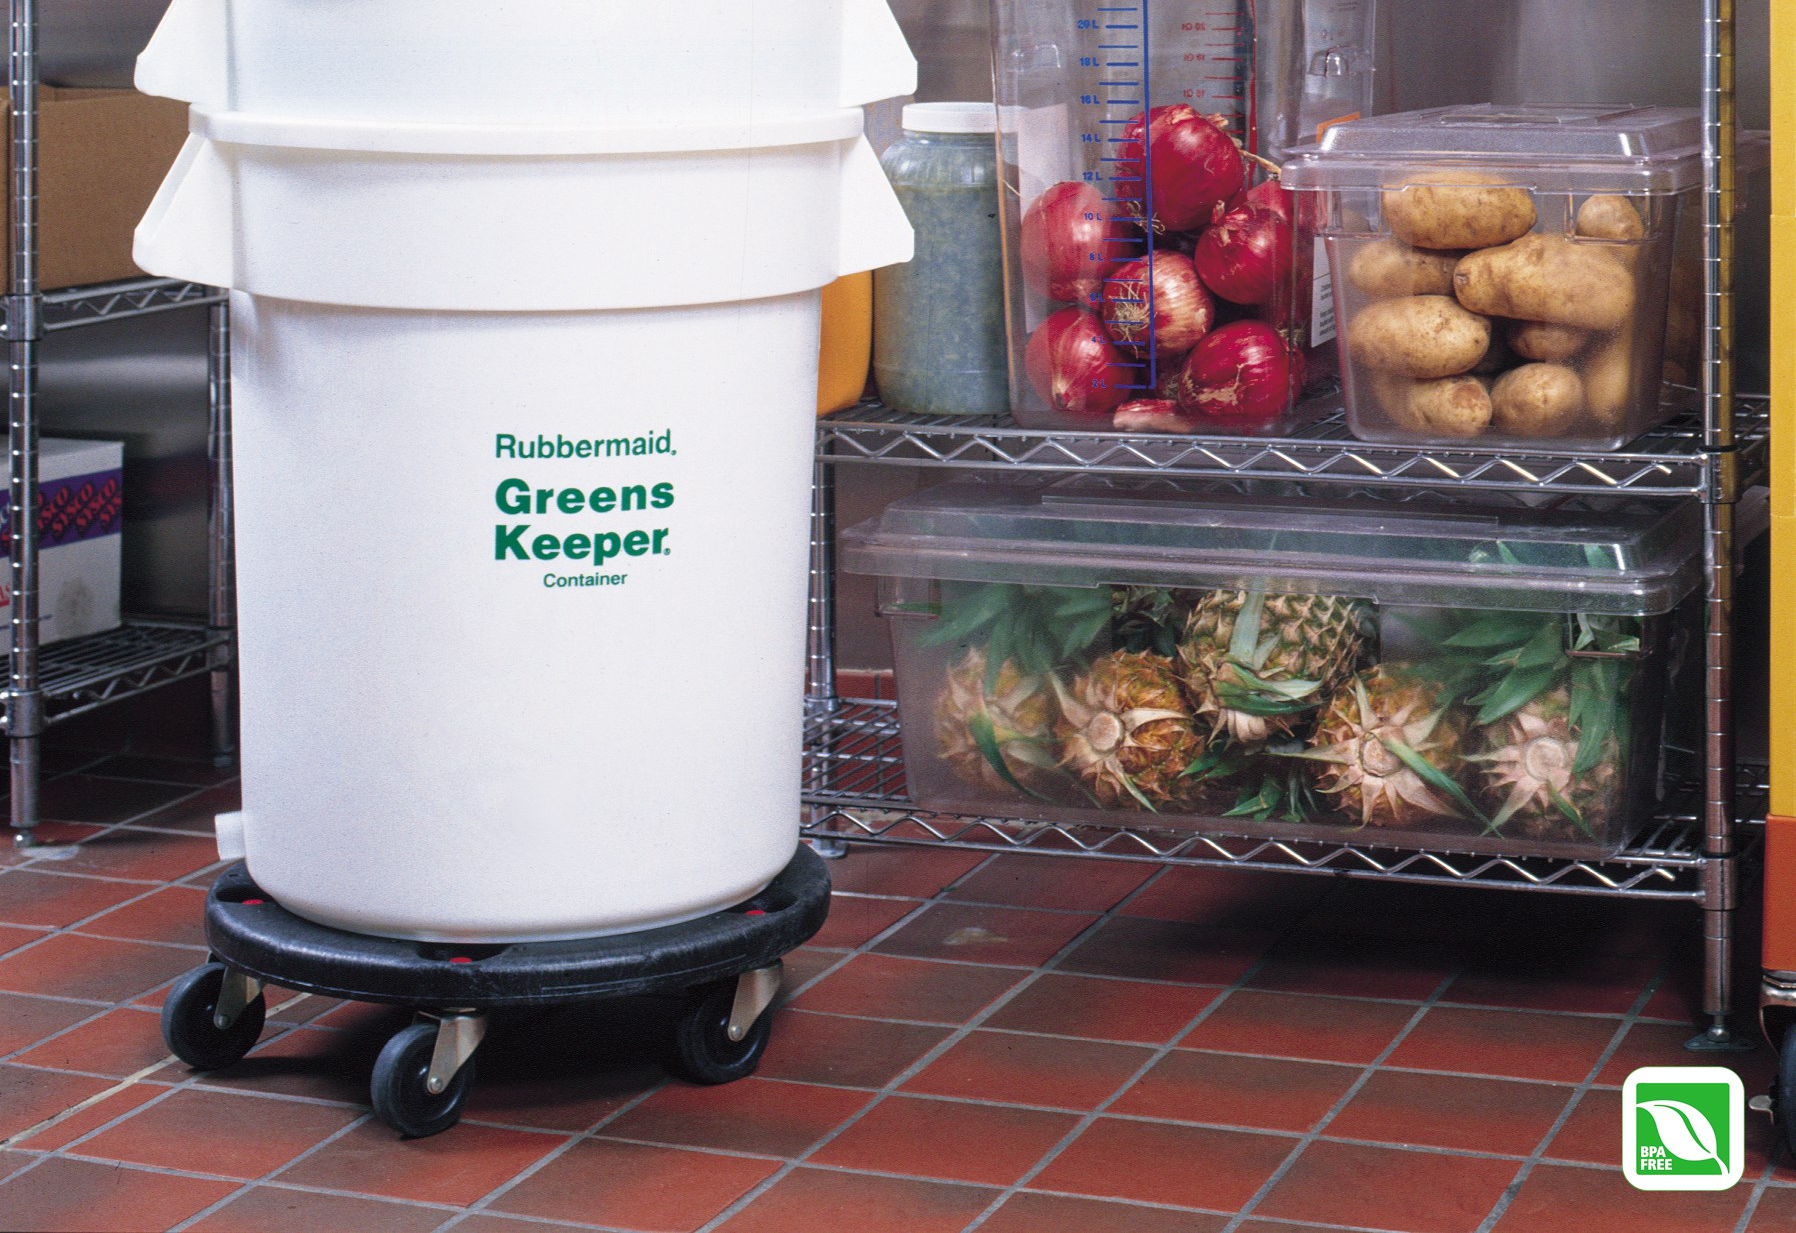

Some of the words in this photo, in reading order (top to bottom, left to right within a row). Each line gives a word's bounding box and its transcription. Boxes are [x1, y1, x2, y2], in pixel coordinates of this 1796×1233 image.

[1077, 20, 1090, 29] 20
[1081, 133, 1092, 143] 14
[1082, 171, 1093, 181] 12
[1084, 212, 1094, 221] 10
[1091, 335, 1097, 343] 4
[1092, 379, 1098, 388] 2
[495, 428, 672, 459] Rubbermaid
[495, 478, 675, 515] Greens
[494, 524, 670, 567] Keeper
[543, 572, 628, 588] Container
